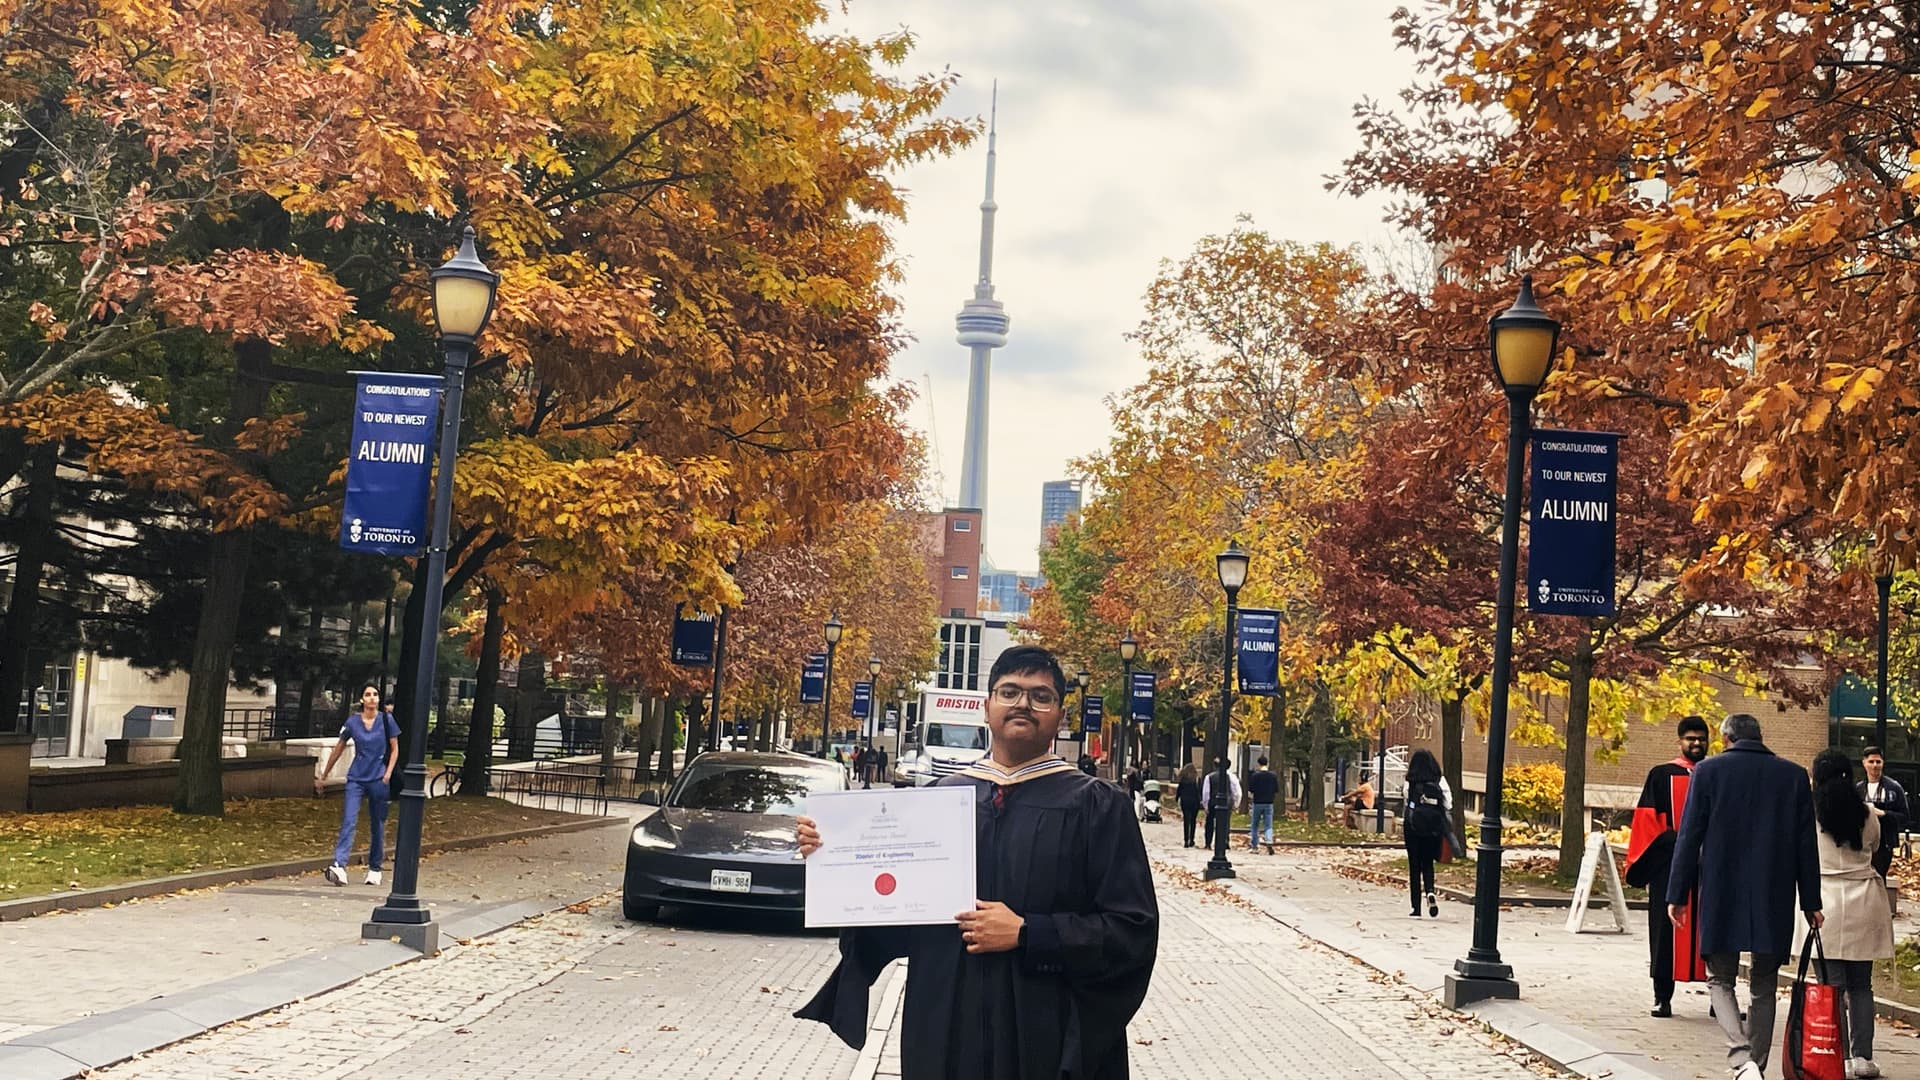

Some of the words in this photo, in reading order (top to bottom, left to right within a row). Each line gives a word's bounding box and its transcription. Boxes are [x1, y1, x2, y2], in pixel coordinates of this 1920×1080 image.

[366, 385, 431, 397] CONGRATULATIONS
[362, 412, 374, 422] TO
[375, 413, 392, 424] OUR
[394, 414, 427, 426] NEWEST
[358, 440, 425, 464] ALUMNI
[1541, 441, 1608, 454] CONGRATULATIONS
[1542, 469, 1553, 480] TO
[1554, 470, 1572, 481] OUR
[1574, 471, 1607, 483] NEWEST
[1541, 499, 1608, 522] ALUMNI
[363, 532, 416, 544] TORONTO
[1552, 592, 1605, 604] TORONTO
[1242, 640, 1275, 653] ALUMNI
[936, 697, 980, 710] BRISTOL
